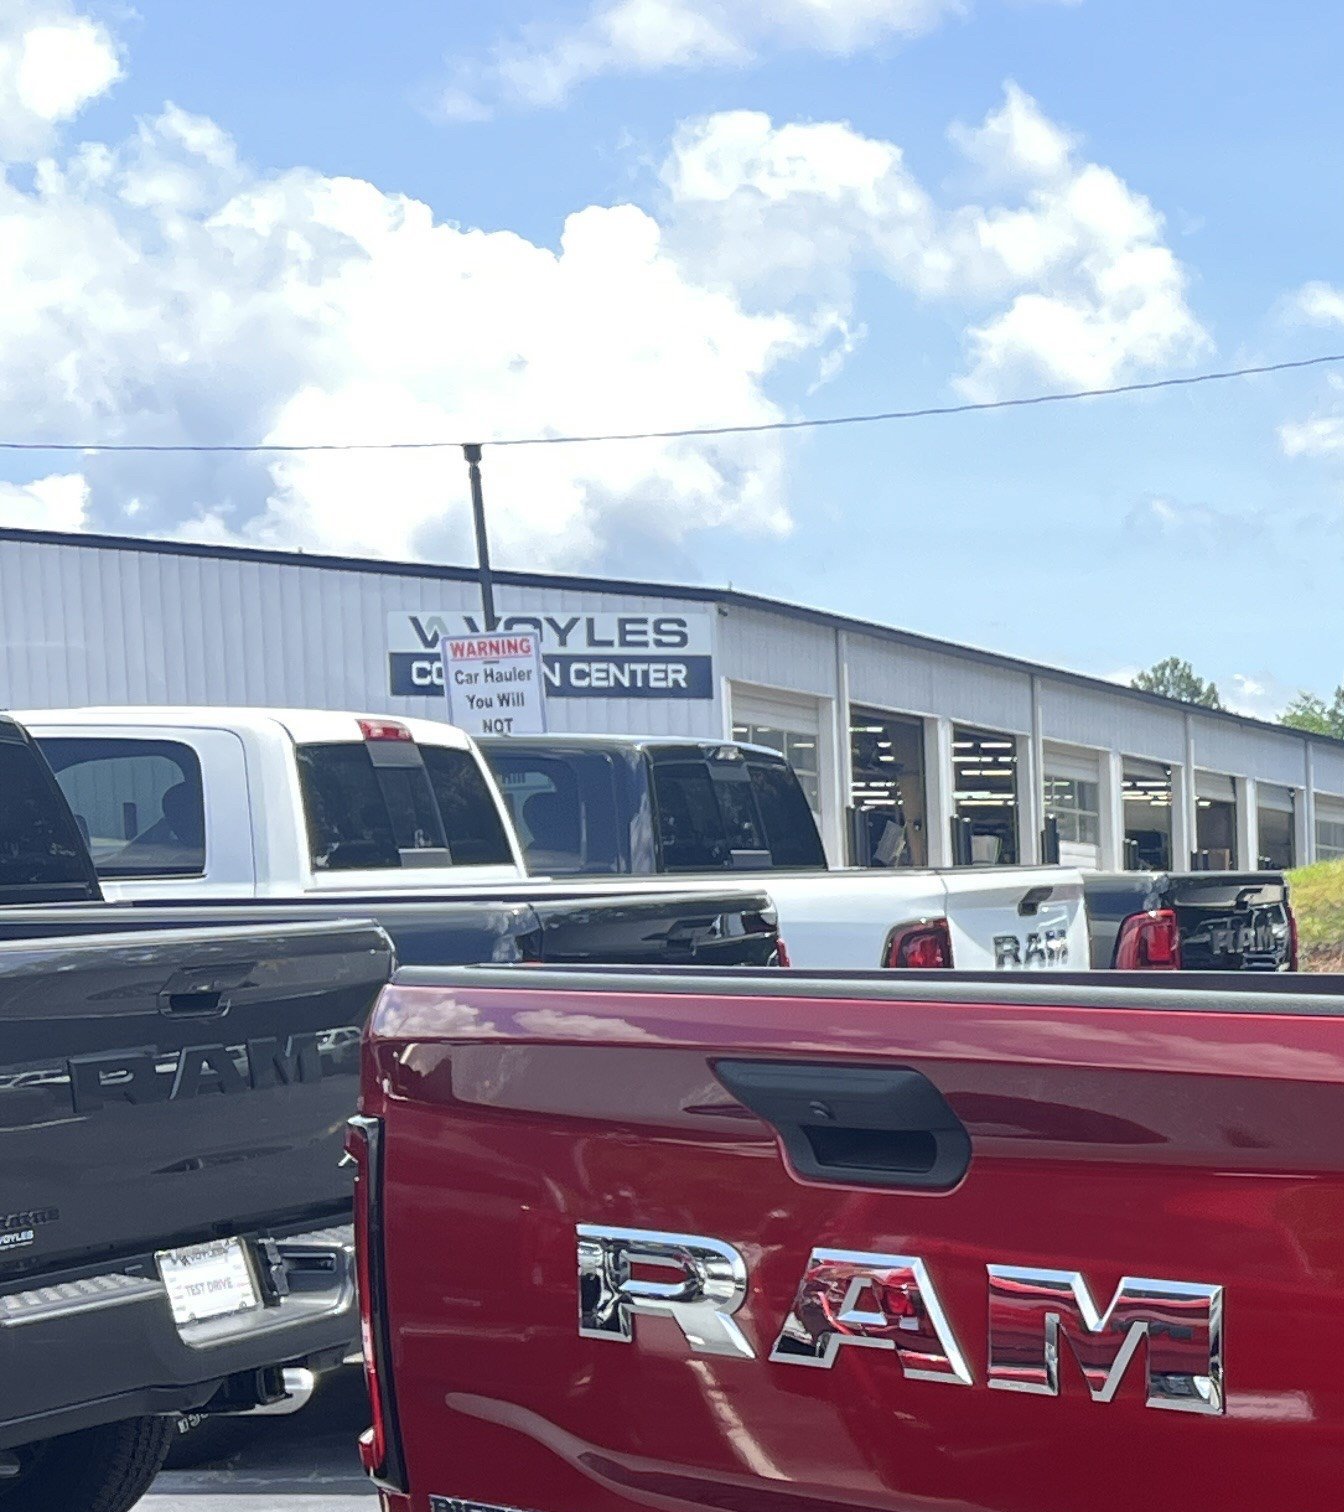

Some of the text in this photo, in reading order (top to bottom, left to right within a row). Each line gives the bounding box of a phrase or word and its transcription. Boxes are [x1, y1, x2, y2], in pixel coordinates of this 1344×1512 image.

[449, 638, 532, 659] WARNING
[454, 670, 479, 686] Car
[484, 667, 533, 683] Hauler
[569, 661, 688, 688] CENTER
[466, 692, 526, 710] You Will
[482, 717, 514, 733] NOT
[993, 928, 1069, 969] RAM
[68, 1032, 325, 1114] RAM
[575, 1222, 1227, 1415] RAM
